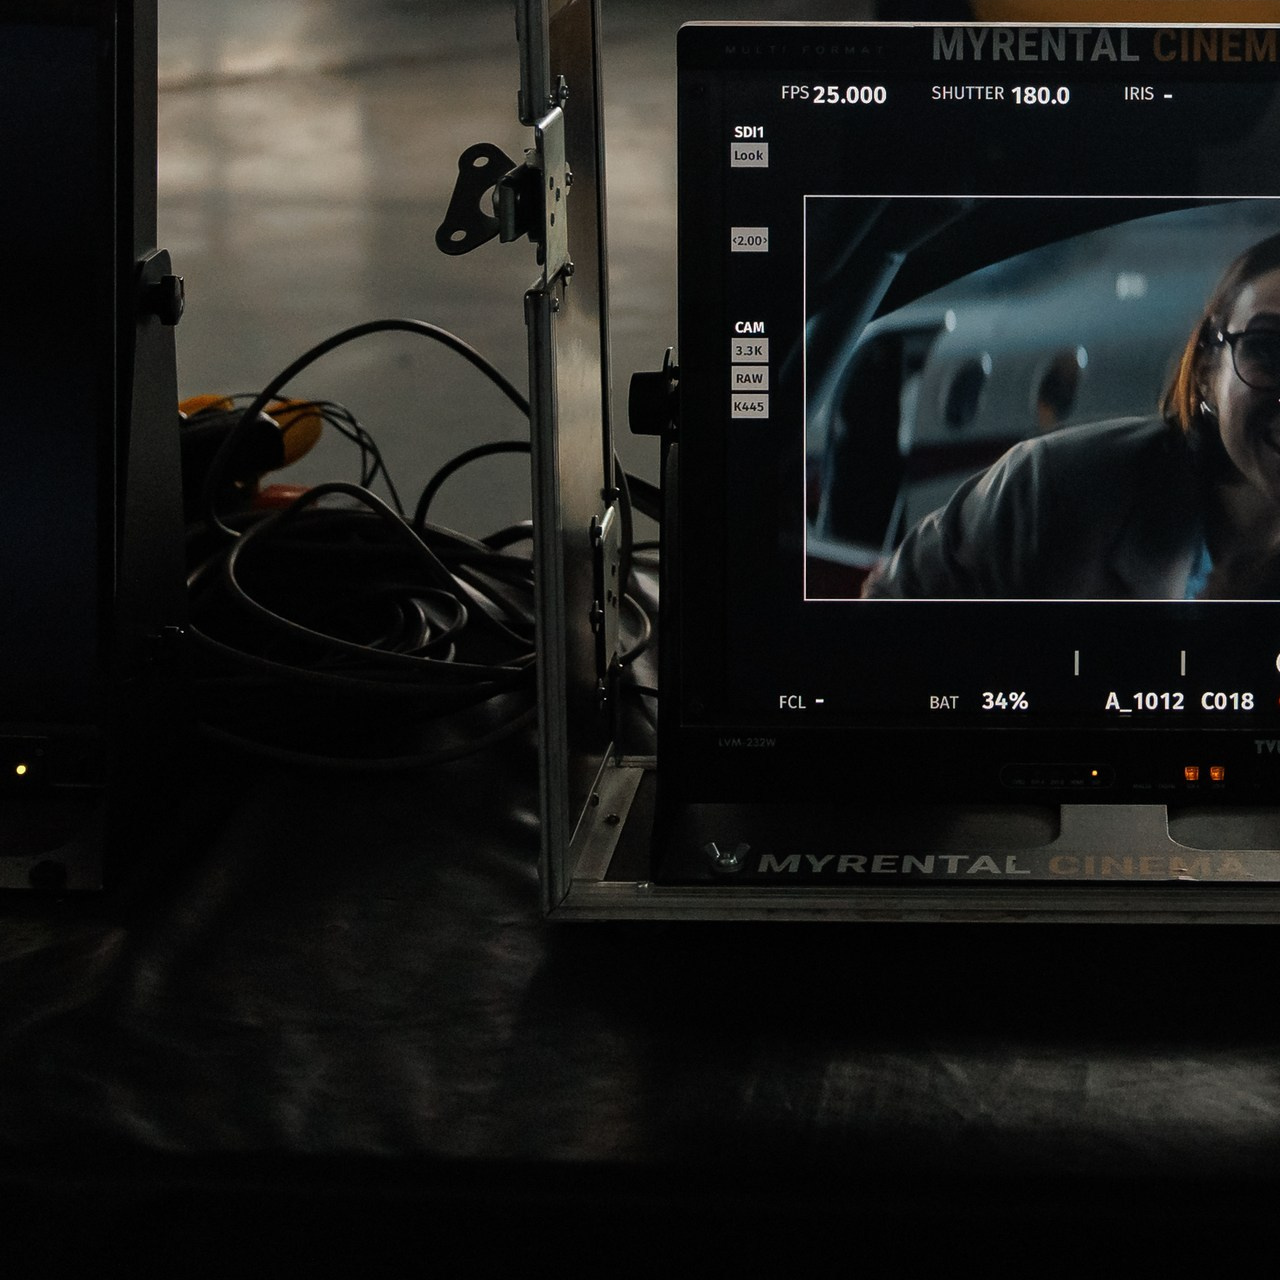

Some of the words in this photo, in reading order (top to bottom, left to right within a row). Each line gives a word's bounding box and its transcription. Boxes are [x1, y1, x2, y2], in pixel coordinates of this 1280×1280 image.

[932, 28, 1140, 62] MYRENTAL
[781, 85, 810, 100] FPS
[813, 85, 887, 105] 25.000
[931, 85, 1005, 100] SHUTTER
[1011, 86, 1070, 105] 180.0
[1124, 86, 1155, 101] IRIS
[734, 125, 764, 139] SDI1
[734, 149, 764, 162] Look
[734, 321, 765, 334] CAM
[735, 345, 763, 357] 3.3K
[735, 373, 764, 384] RAW
[733, 401, 765, 412] K445
[779, 694, 806, 709] FCL
[929, 695, 960, 710] BAT
[981, 691, 1029, 710] 34%
[1104, 691, 1185, 713] A_1012
[1200, 691, 1255, 711] C018
[757, 854, 1032, 875] MYRENTAL
